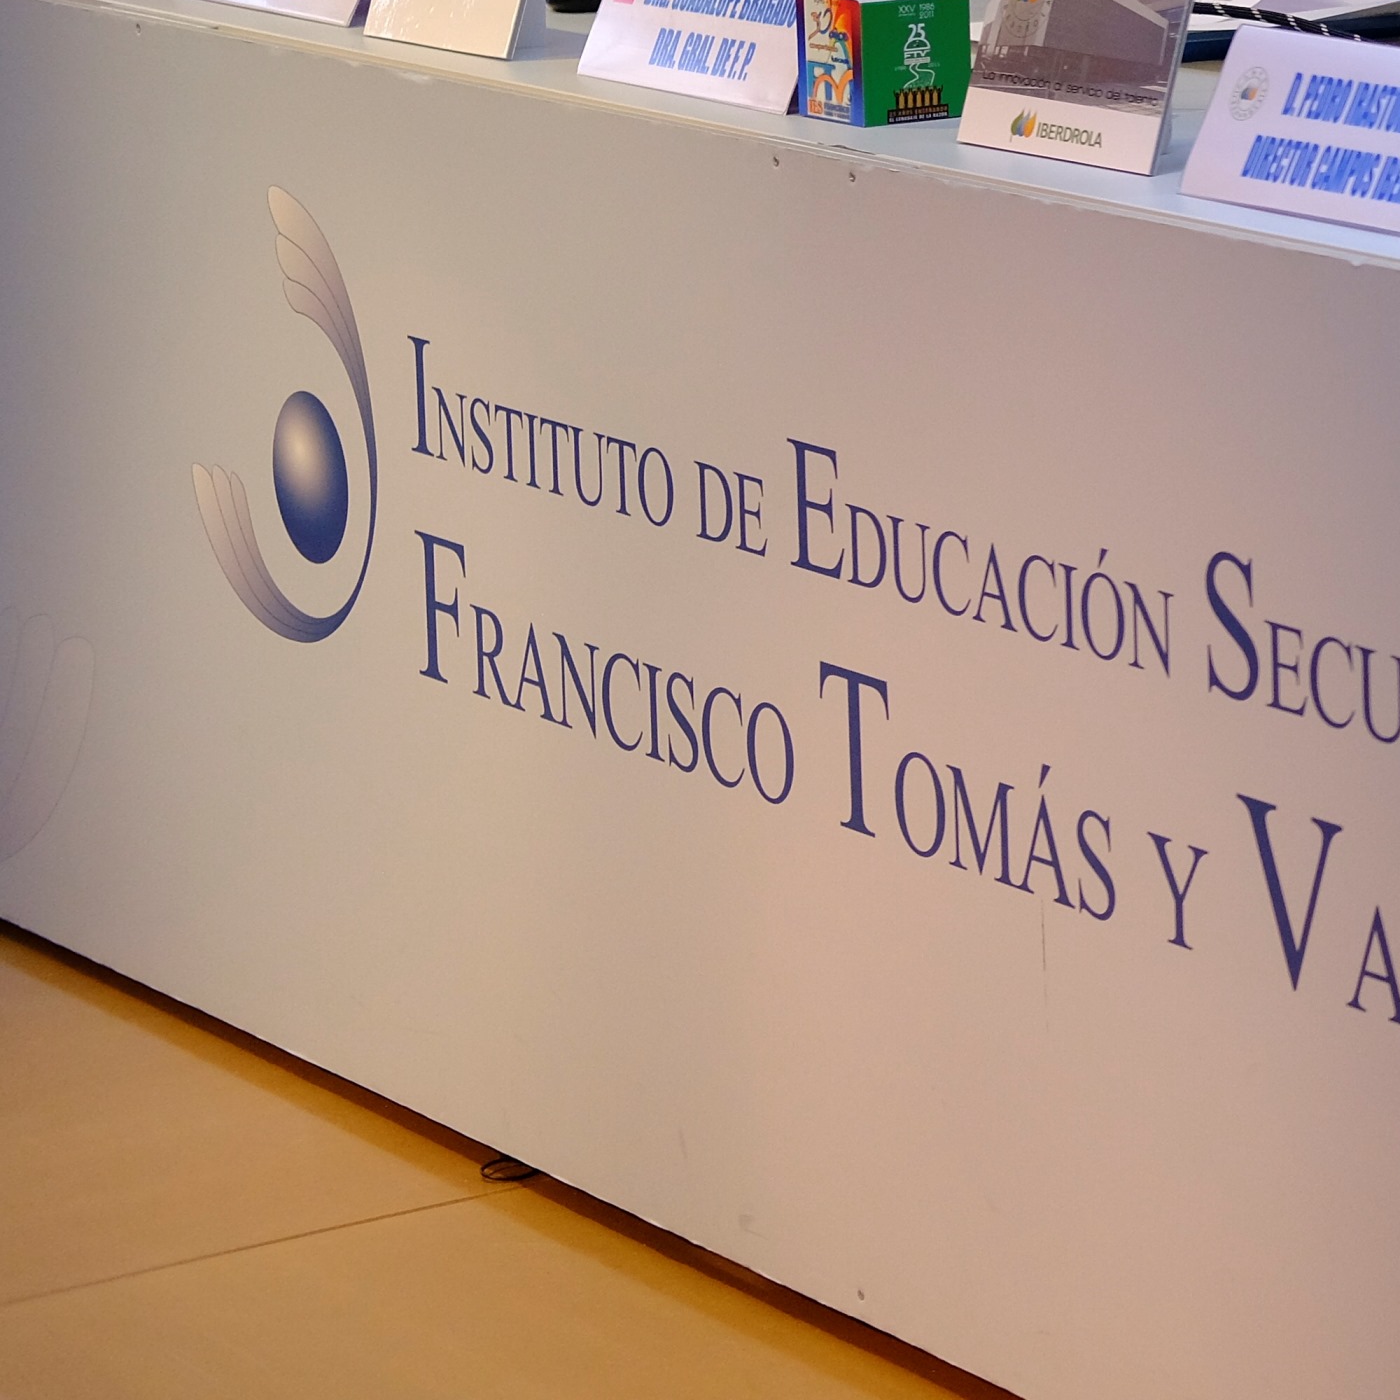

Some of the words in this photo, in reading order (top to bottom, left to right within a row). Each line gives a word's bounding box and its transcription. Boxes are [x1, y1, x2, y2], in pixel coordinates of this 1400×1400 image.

[649, 27, 682, 70] DRA.
[908, 23, 927, 42] 25
[1065, 83, 1104, 99] servicio
[1106, 88, 1122, 101] del
[1297, 74, 1354, 124] PEDRO
[1035, 121, 1104, 149] IBERDROLA
[1239, 134, 1320, 188] DIRECTOR
[1310, 145, 1383, 199] CAMPUS
[407, 334, 675, 528] INSTITUTO
[693, 459, 769, 558] DE
[786, 437, 1176, 680] EDUCACIÓN
[414, 528, 796, 806] FRANCISCO
[817, 660, 1118, 923] TOMÁS
[1146, 831, 1209, 952] Y
